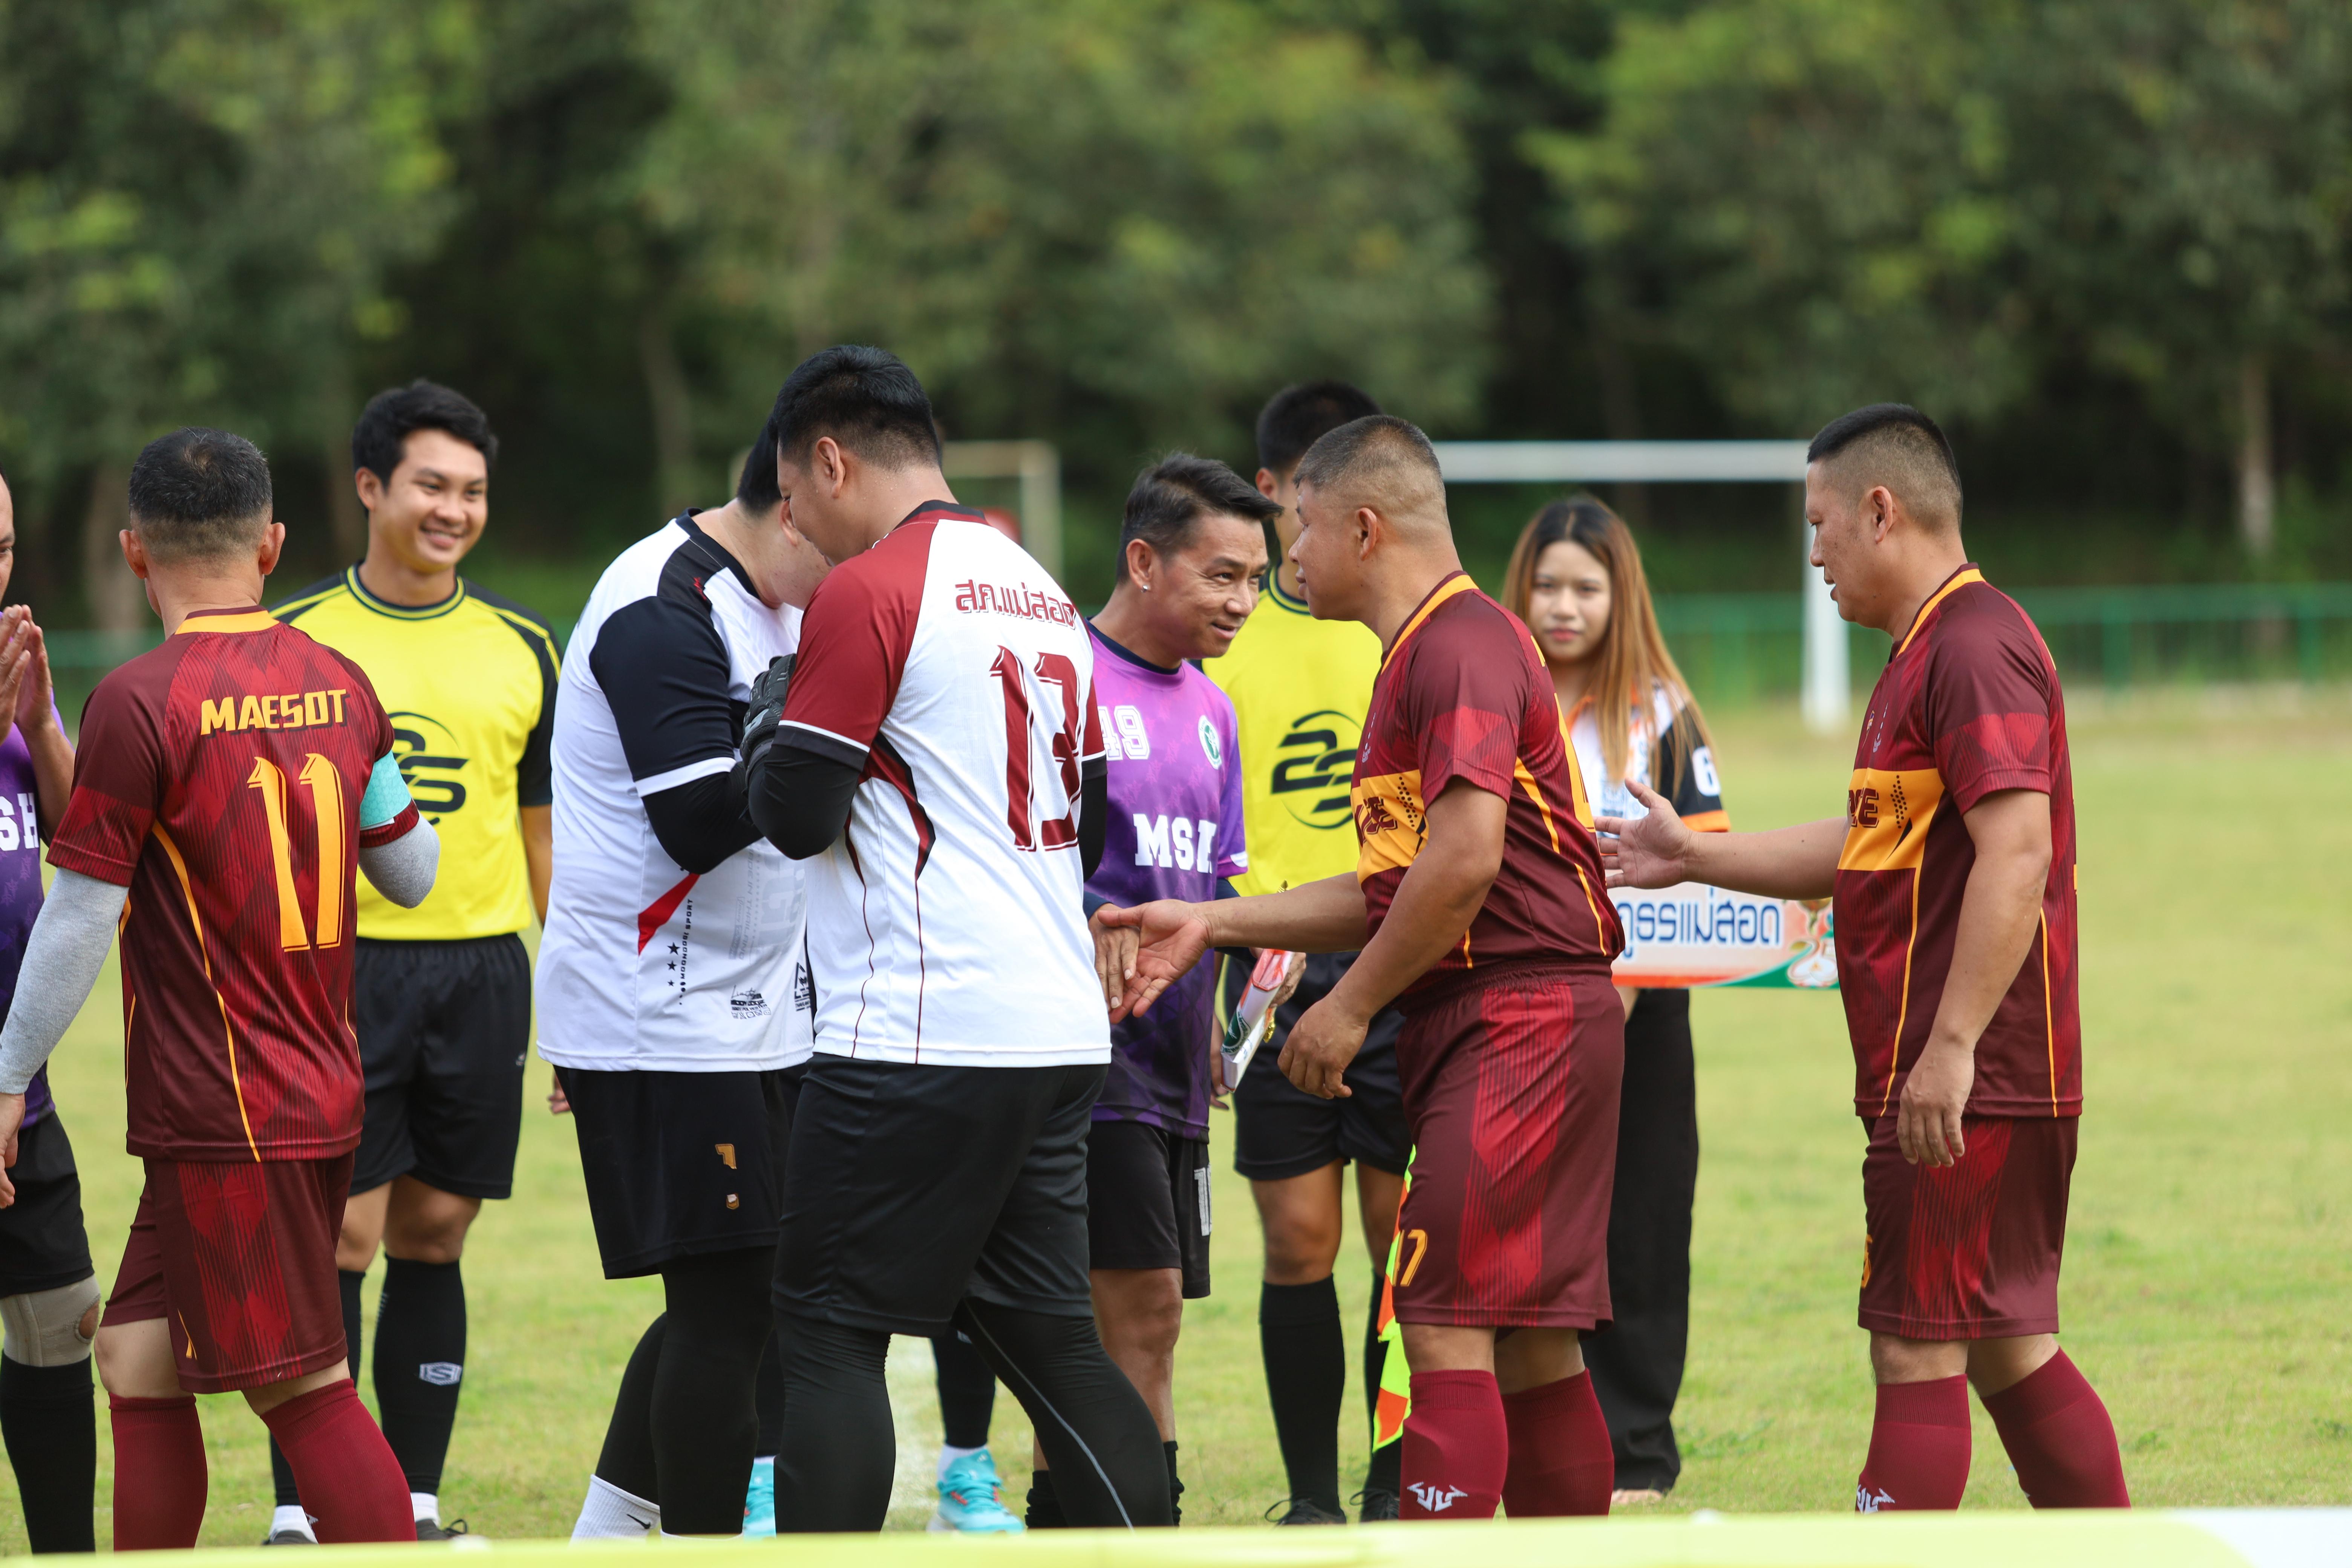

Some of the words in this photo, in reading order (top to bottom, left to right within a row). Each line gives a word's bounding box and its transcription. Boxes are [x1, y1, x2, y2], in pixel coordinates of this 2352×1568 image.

[200, 689, 348, 735] MAESOT
[989, 645, 1081, 851] 13
[1097, 705, 1151, 761] 49
[247, 753, 346, 951] 11
